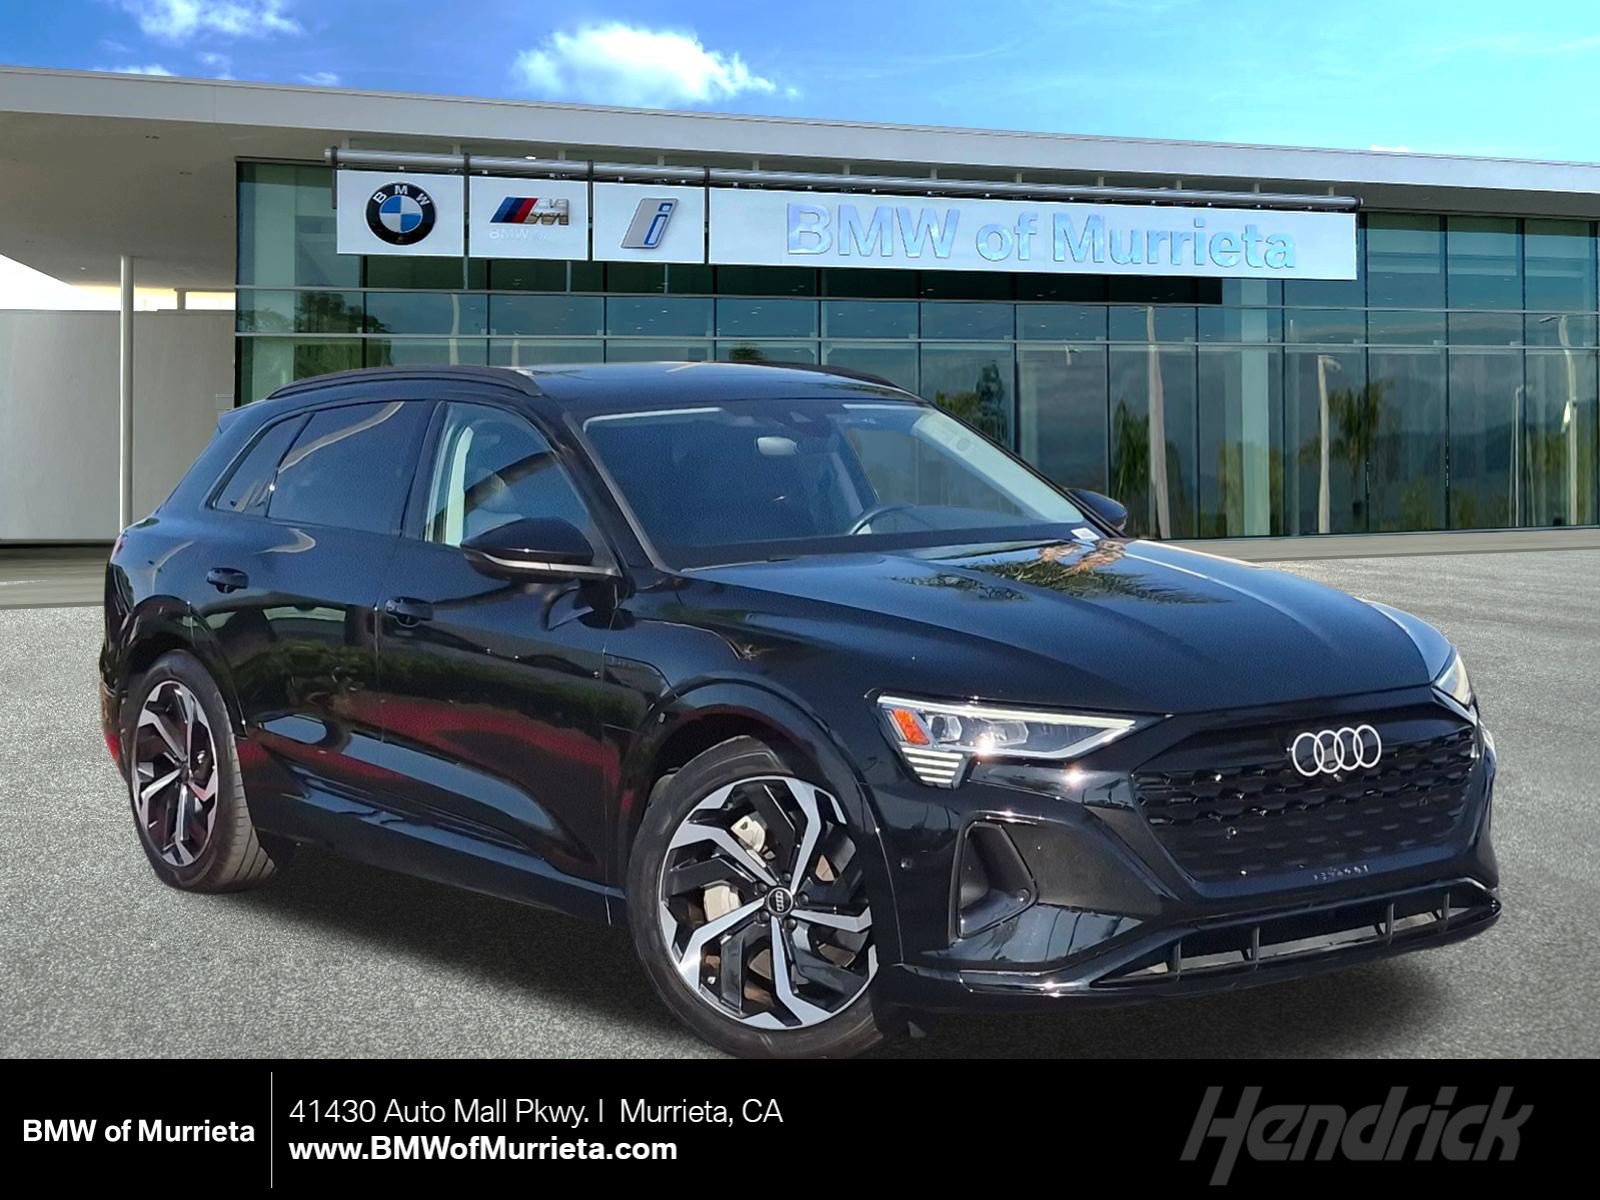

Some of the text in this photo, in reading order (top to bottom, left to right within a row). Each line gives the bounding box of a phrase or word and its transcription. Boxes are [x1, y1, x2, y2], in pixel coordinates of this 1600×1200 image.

[373, 185, 430, 206] BMW
[787, 202, 1296, 269] BMW of Murrieta
